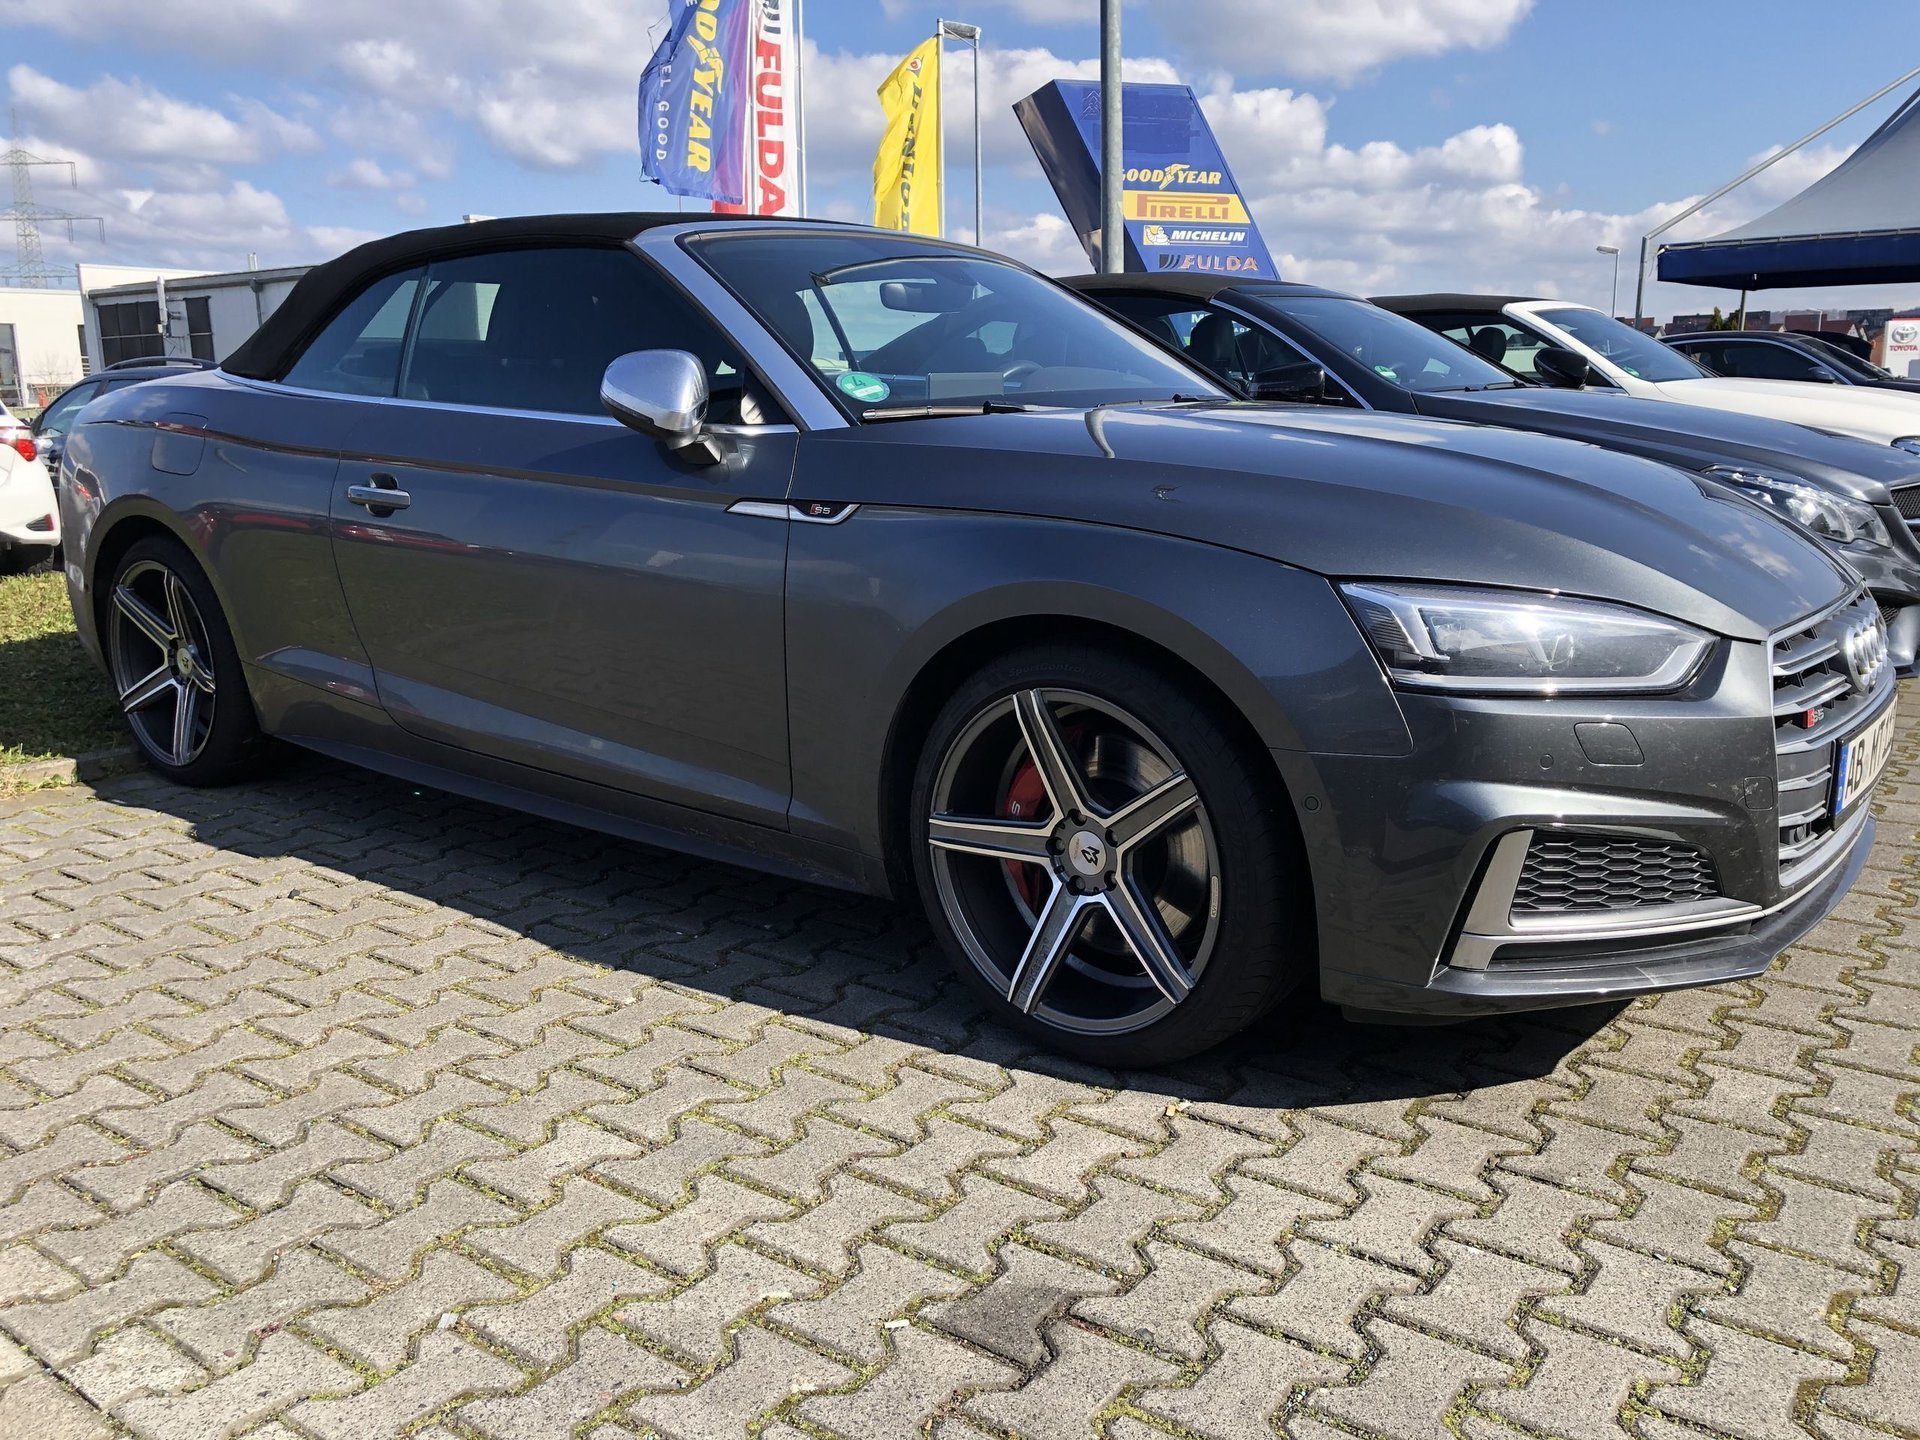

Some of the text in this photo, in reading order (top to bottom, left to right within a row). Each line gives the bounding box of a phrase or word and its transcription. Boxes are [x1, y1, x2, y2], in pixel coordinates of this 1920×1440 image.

[756, 39, 785, 216] FULDA
[1136, 193, 1230, 219] PIRELLI
[1171, 230, 1246, 242] MICHELIN
[1179, 254, 1259, 271] FULDA
[1889, 344, 1918, 352] TOYOTA
